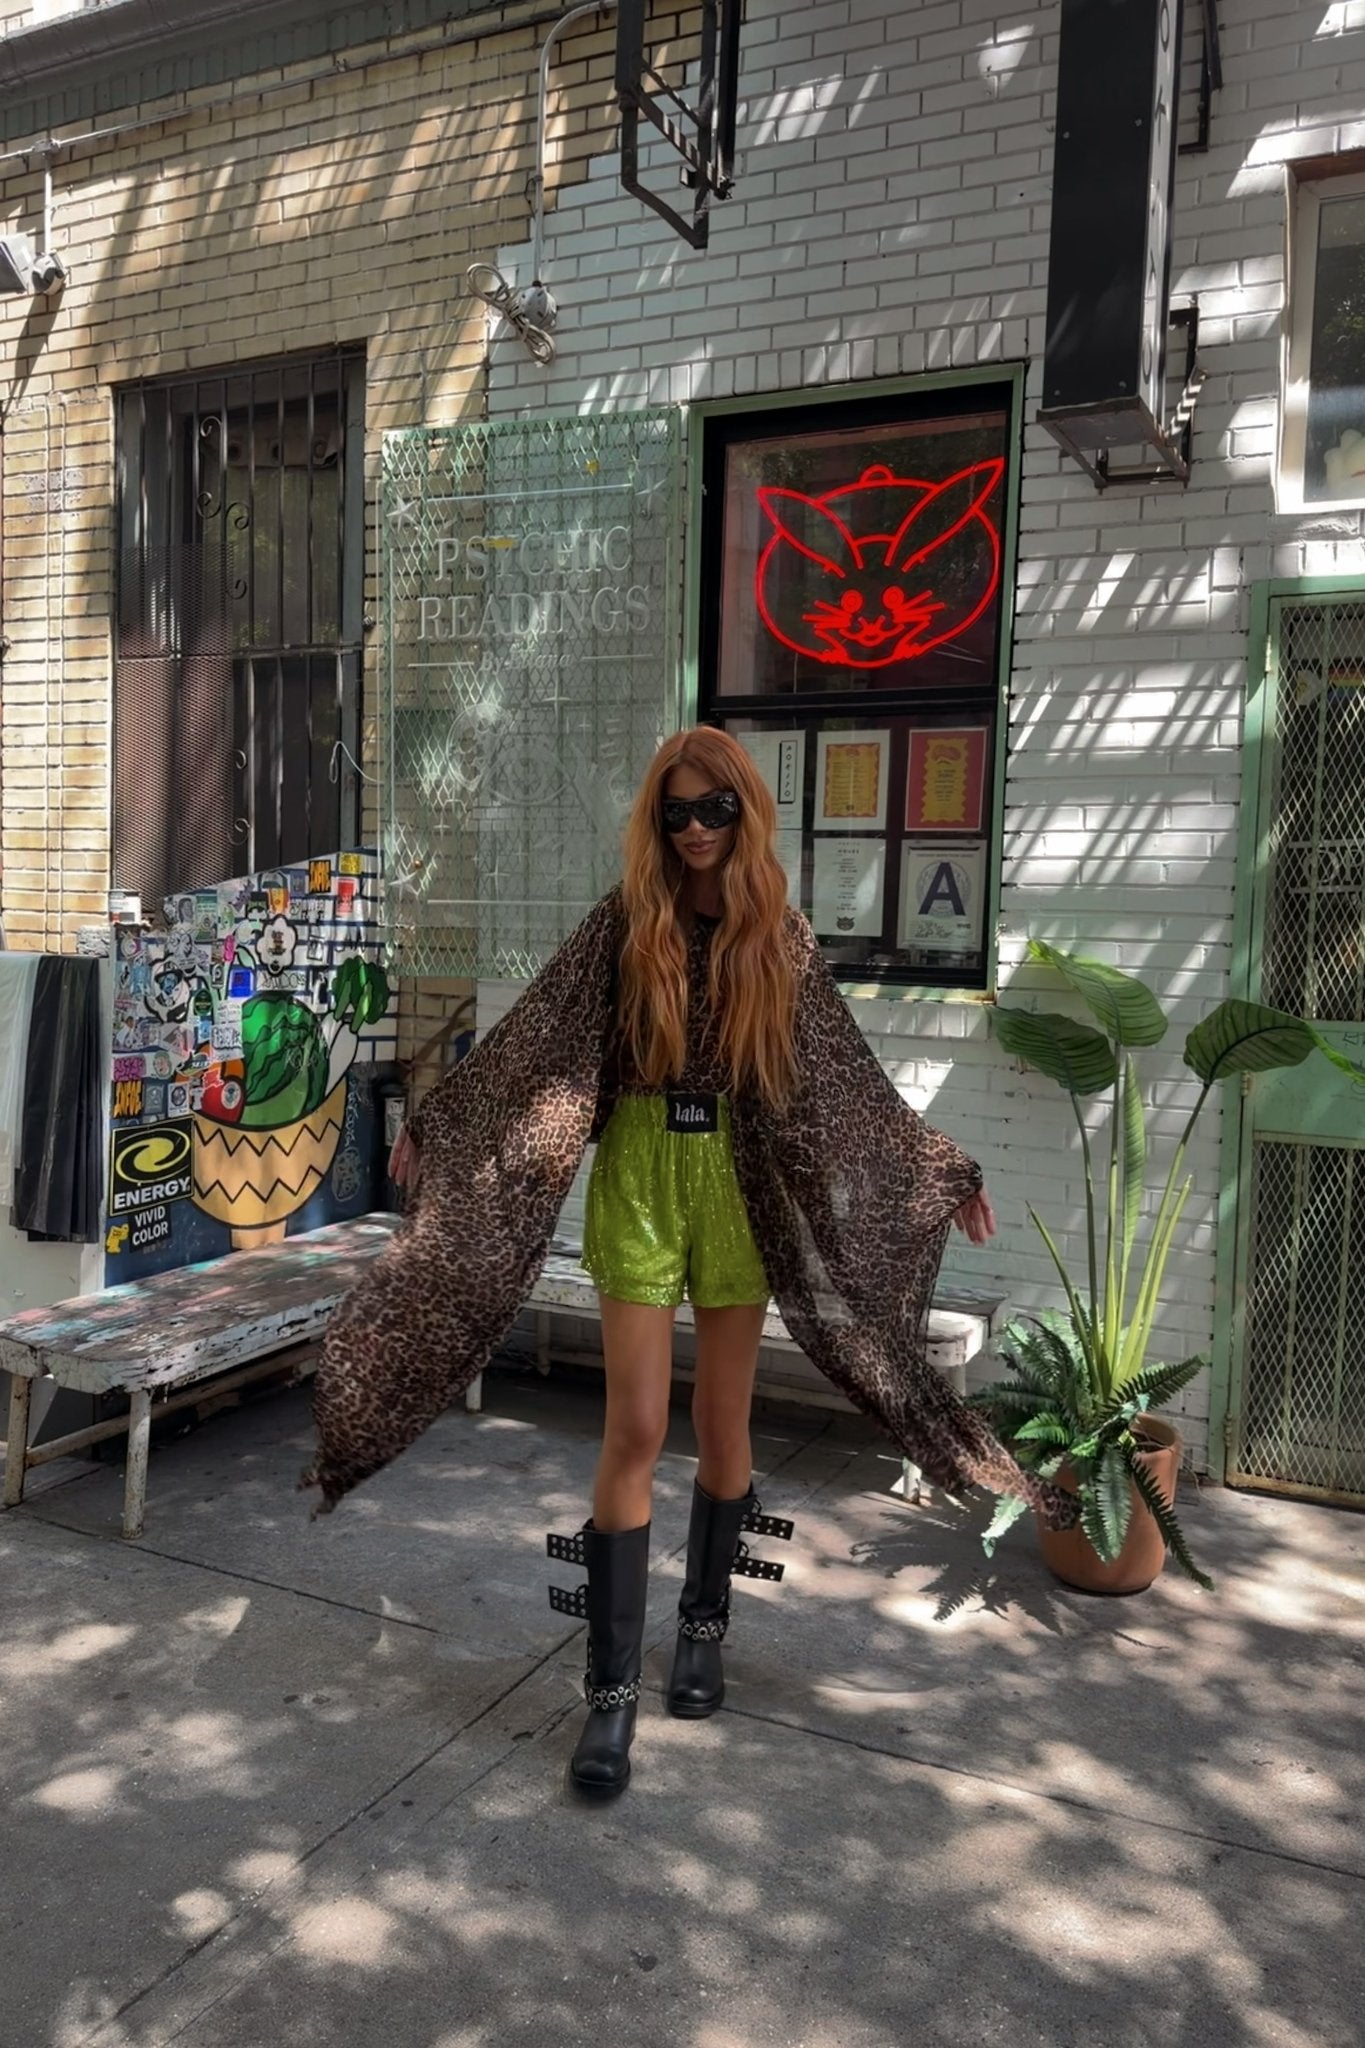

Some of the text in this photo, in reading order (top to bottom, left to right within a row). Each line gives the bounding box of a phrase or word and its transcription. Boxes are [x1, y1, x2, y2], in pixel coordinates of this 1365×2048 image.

[435, 526, 632, 581] PSYCHIC
[417, 585, 650, 640] READINGS
[918, 861, 966, 916] A
[132, 1221, 169, 1246] COLOR
[134, 1206, 166, 1228] VIVID
